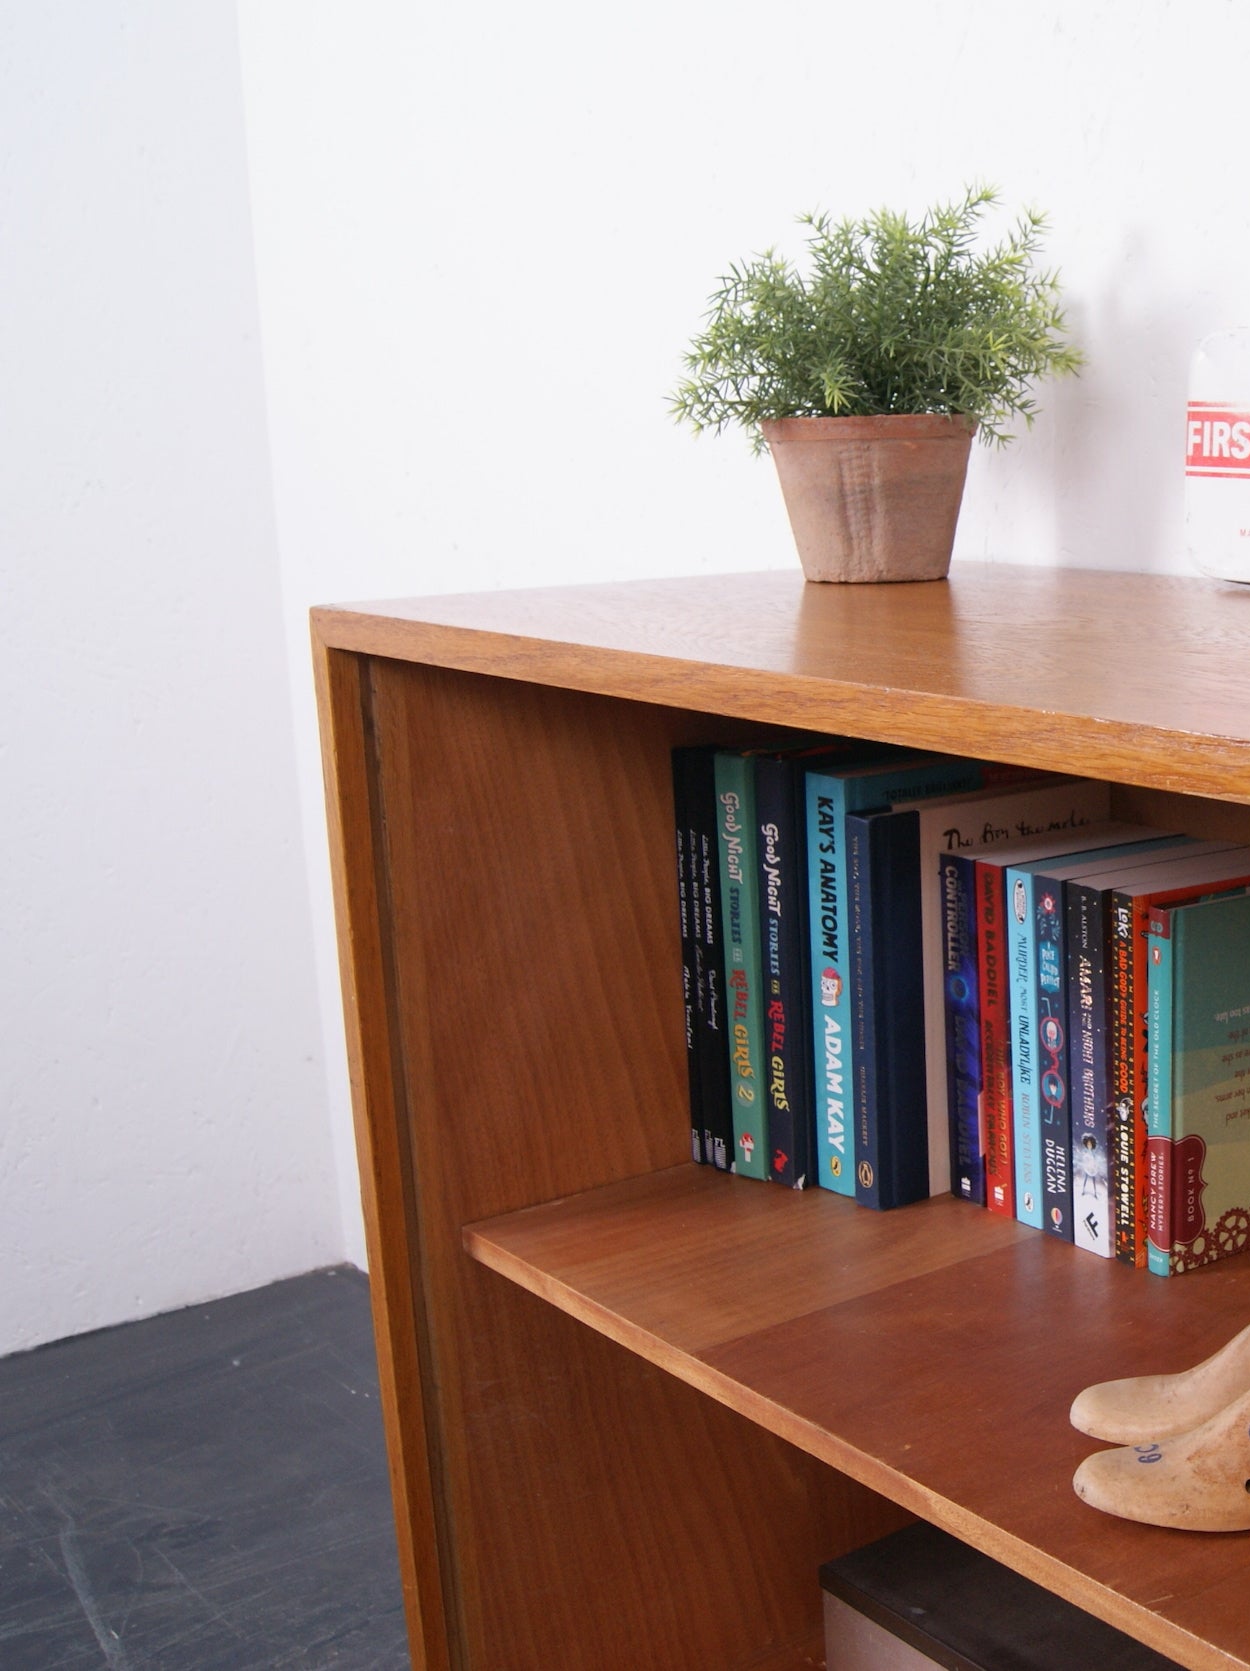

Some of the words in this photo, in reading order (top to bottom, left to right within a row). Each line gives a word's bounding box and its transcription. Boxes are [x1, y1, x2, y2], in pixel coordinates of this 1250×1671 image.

[817, 796, 836, 854] KAY'S
[693, 900, 701, 938] DREAMS
[729, 887, 742, 945] STORIES
[820, 859, 838, 963] ANATOMY
[945, 866, 961, 971] CONTROLLER
[983, 871, 995, 925] DAVID
[705, 906, 713, 945] DREAMS
[769, 918, 781, 976] STORIES
[1119, 940, 1127, 948] A
[985, 930, 997, 1007] BADDIEL
[1016, 933, 1028, 983] MURDER
[1079, 955, 1093, 1011] AMARI
[1118, 949, 1128, 970] BAD
[729, 969, 749, 1023] REBEL
[1119, 1001, 1127, 1025] GUIDE
[768, 1000, 784, 1053] REBEL
[1019, 1016, 1033, 1085] UNLADYLIKE
[1082, 1029, 1094, 1064] NIGHT
[1119, 1036, 1127, 1061] BEING
[824, 1015, 843, 1095] ADAM
[1118, 1061, 1129, 1093] GOOD
[1153, 1062, 1160, 1075] OF
[738, 1084, 754, 1103] 2
[997, 1099, 1006, 1131] WHO
[1022, 1093, 1031, 1127] ROBIN
[1082, 1067, 1095, 1128] BROTHERS
[826, 1098, 845, 1154] KAY
[1120, 1125, 1129, 1164] LOUIE
[1045, 1139, 1056, 1194] DUGGAN
[1055, 1145, 1066, 1193] HELENA
[1120, 1166, 1130, 1226] STOWELL
[1187, 1189, 1195, 1223] BOOK
